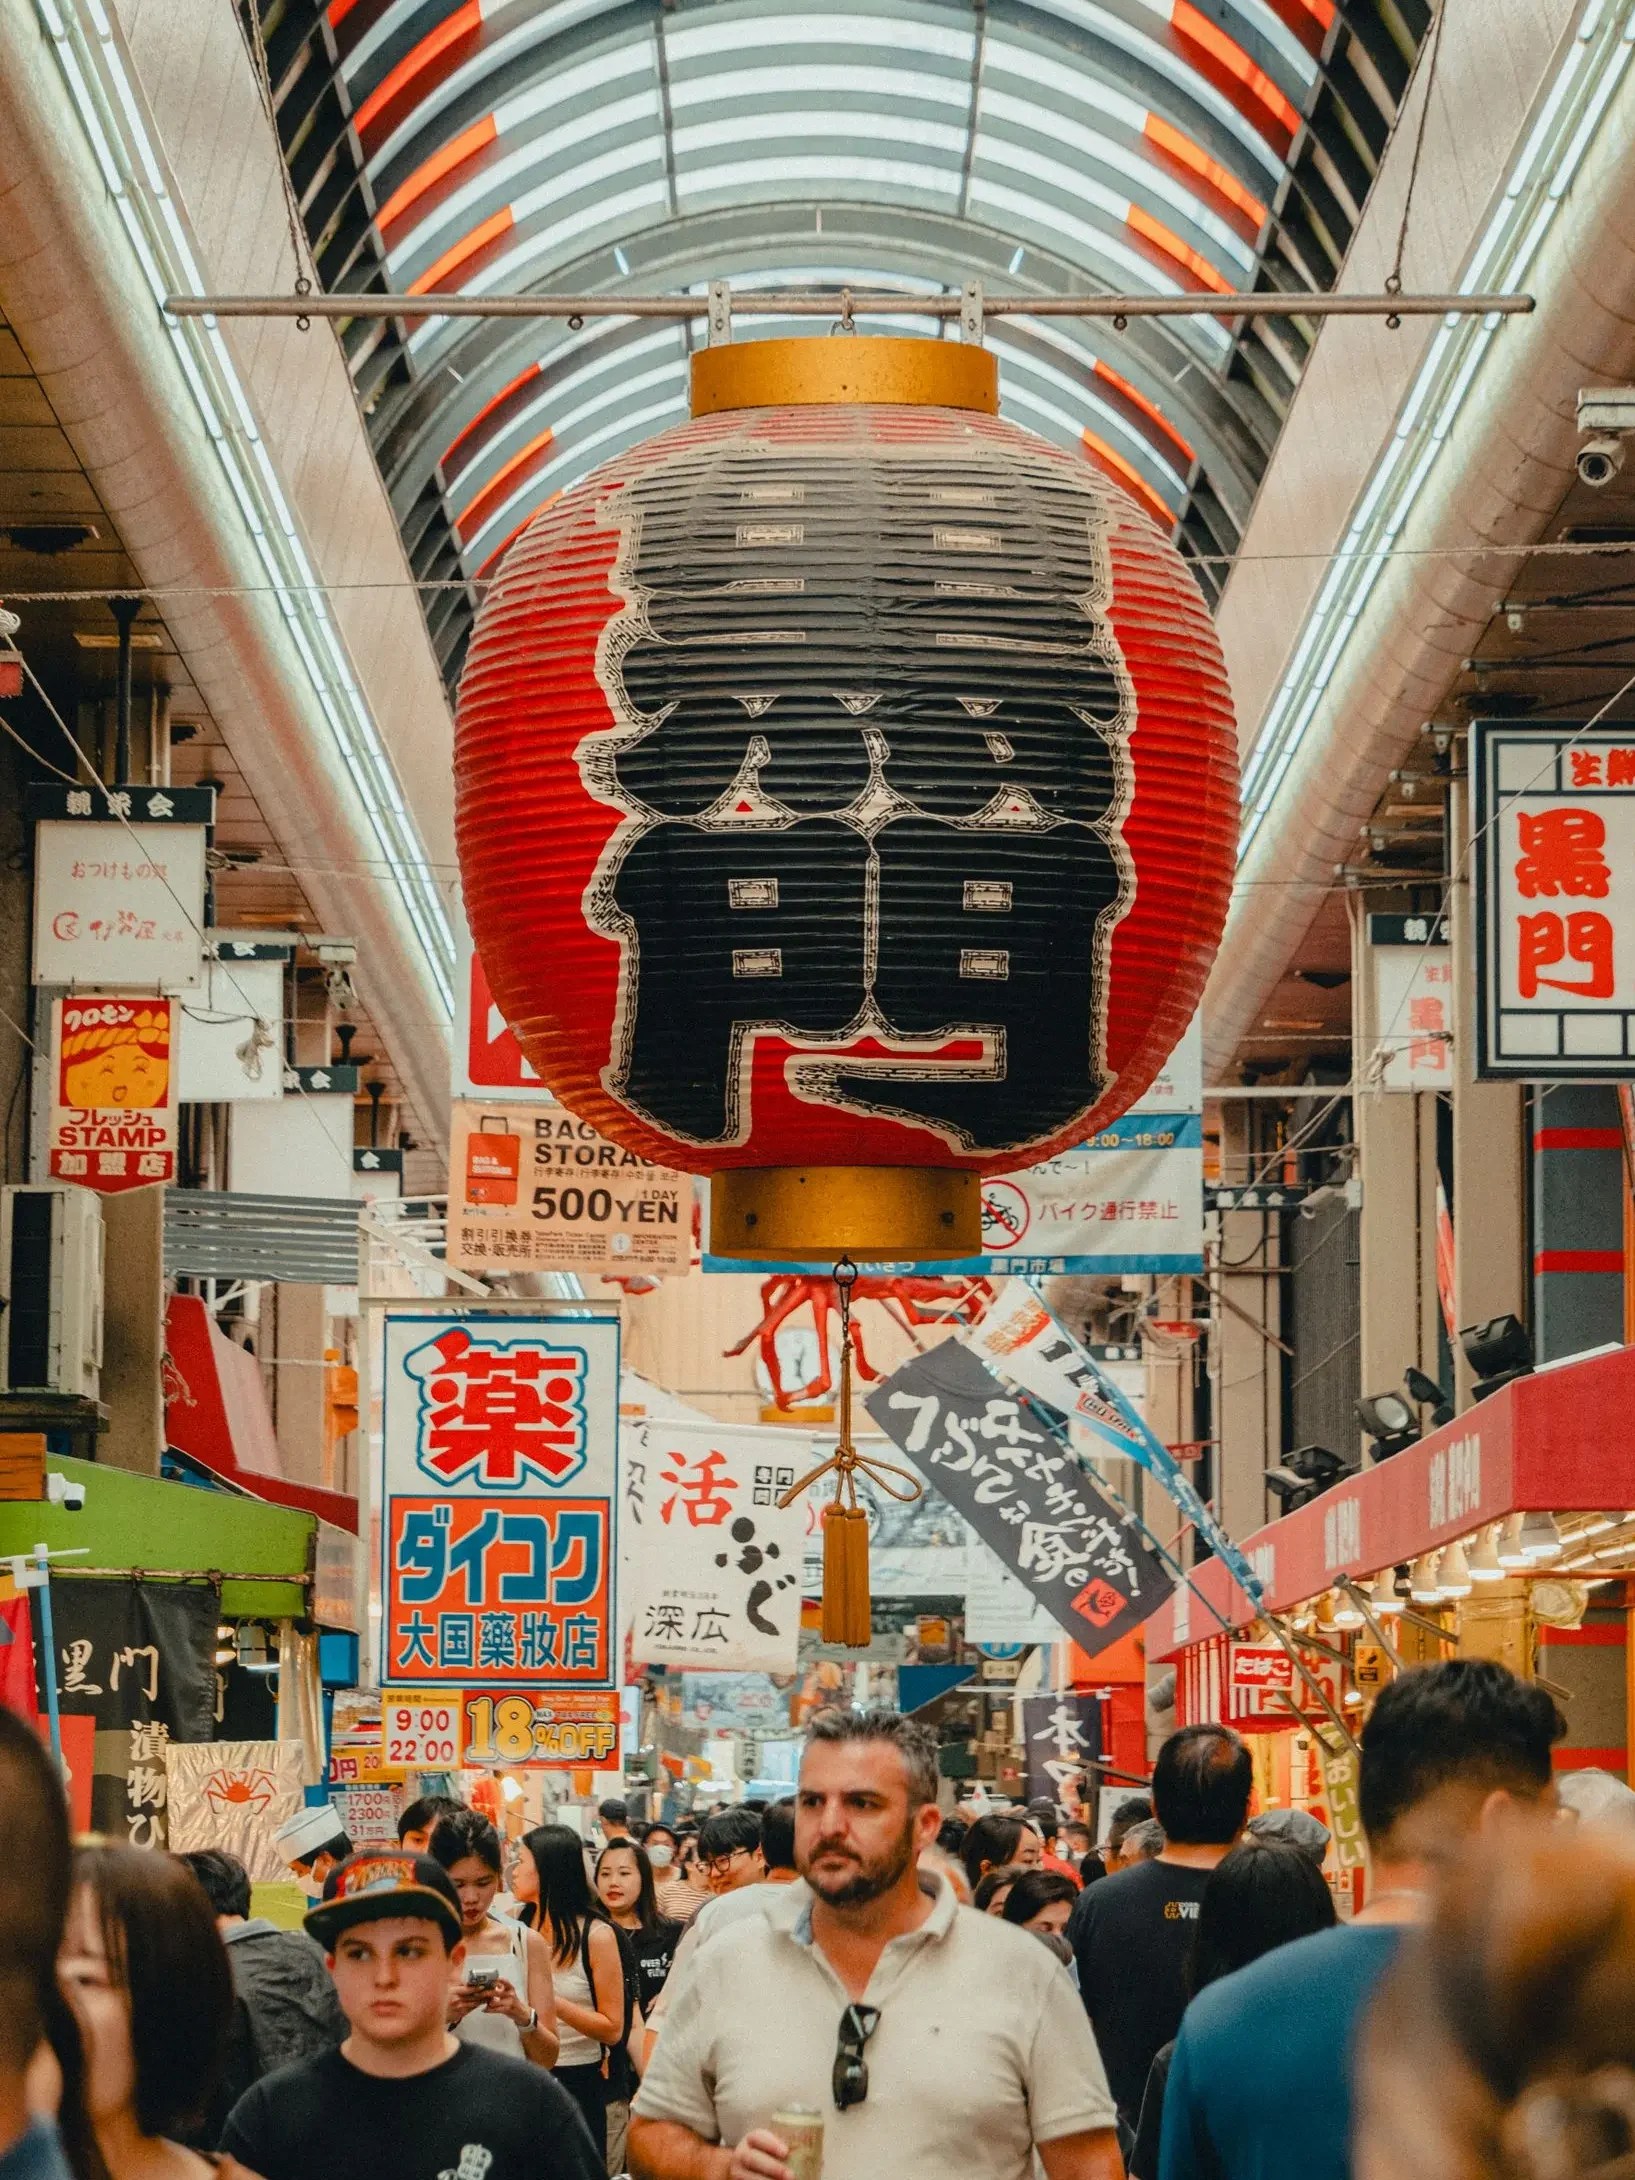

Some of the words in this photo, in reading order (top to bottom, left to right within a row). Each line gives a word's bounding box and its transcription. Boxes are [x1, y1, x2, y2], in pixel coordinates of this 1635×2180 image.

[1515, 808, 1615, 999] 黒門
[64, 1004, 135, 1031] クロモン
[69, 1109, 154, 1126] フレッシュ
[59, 1127, 166, 1147] STAMP
[59, 1151, 166, 1177] 加盟店
[652, 1190, 679, 1200] DAY
[1038, 1201, 1179, 1221] バイク通行禁止
[404, 1328, 582, 1482] 薬
[660, 1449, 738, 1527] 活
[397, 1506, 602, 1606] ダイコク
[644, 1605, 730, 1643] 深広
[396, 1710, 450, 1731] 9:00
[390, 1740, 455, 1762] 22:00
[1326, 1755, 1364, 1867] おいしい
